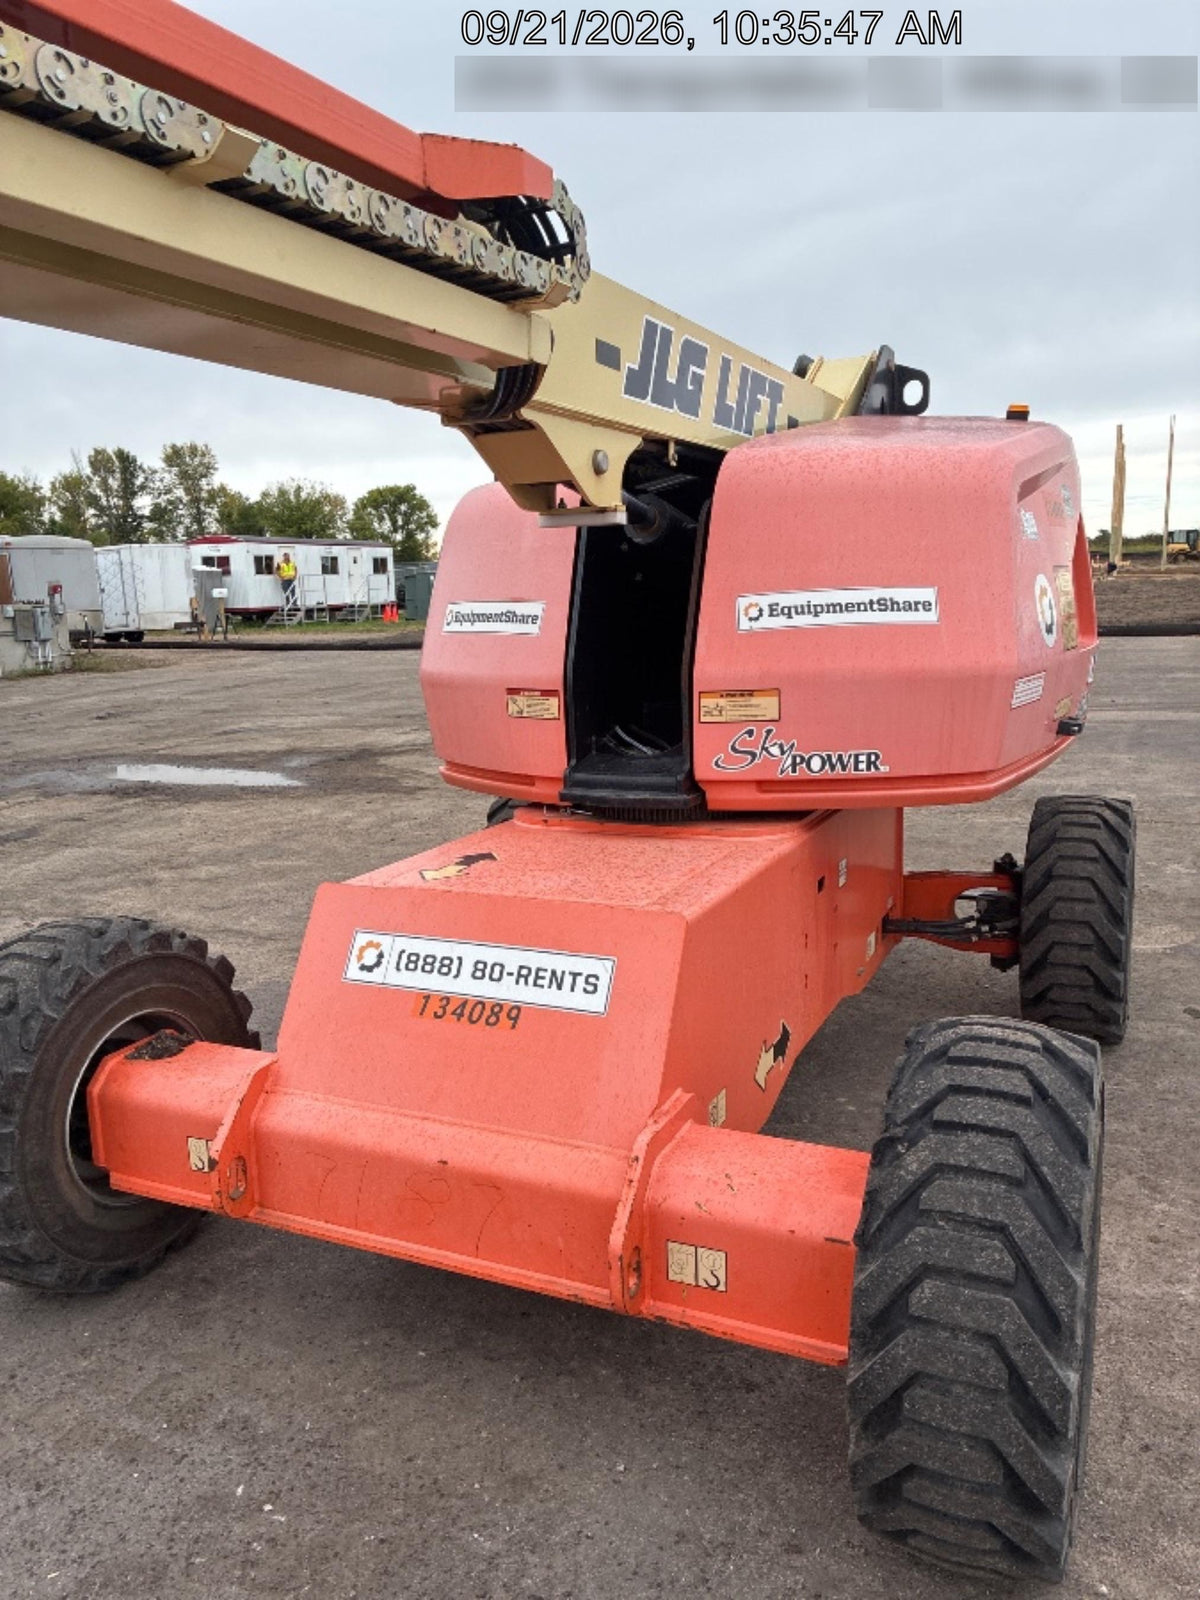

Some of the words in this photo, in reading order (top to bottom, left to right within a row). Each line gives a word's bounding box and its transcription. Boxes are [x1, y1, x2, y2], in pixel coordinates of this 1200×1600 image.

[621, 314, 710, 422] JLG
[712, 352, 785, 438] LIFT
[452, 609, 540, 627] EquipmentShare
[767, 596, 934, 619] EquipmentShare
[395, 949, 463, 979] (888)
[471, 959, 600, 995] 80-RENTS
[418, 994, 522, 1030] 134089
